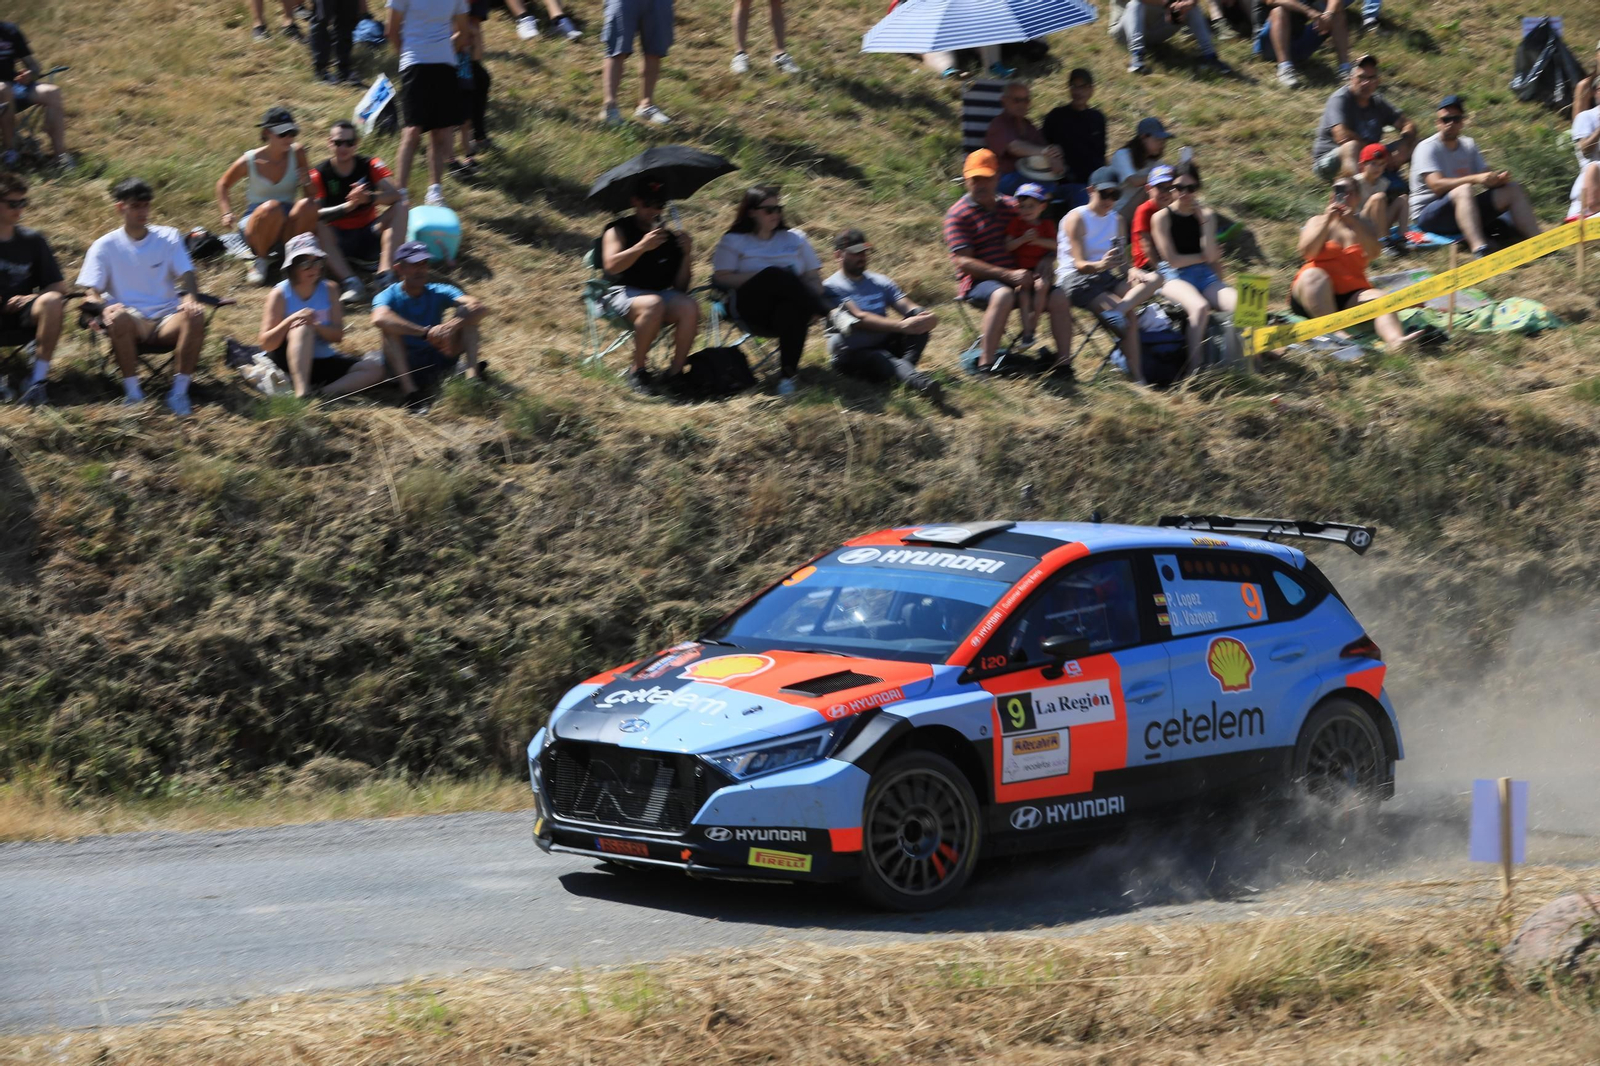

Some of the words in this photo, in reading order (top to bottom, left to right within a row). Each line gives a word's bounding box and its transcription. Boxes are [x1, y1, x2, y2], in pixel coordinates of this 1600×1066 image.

[878, 549, 1005, 574] HYUNDAI
[1175, 591, 1202, 609] Lopez
[1240, 581, 1263, 620] 9
[979, 611, 1002, 636] HYUNDAI
[1182, 611, 1218, 627] Vazquez
[596, 686, 728, 716] cetelem
[848, 688, 902, 711] HYUNDAI
[1035, 699, 1057, 715] La
[1007, 697, 1026, 729] 9
[1144, 700, 1265, 760] cetelem
[1046, 795, 1125, 824] HYUNDAI
[735, 828, 807, 842] HYUNDAI
[755, 851, 807, 869] PIRELLI
